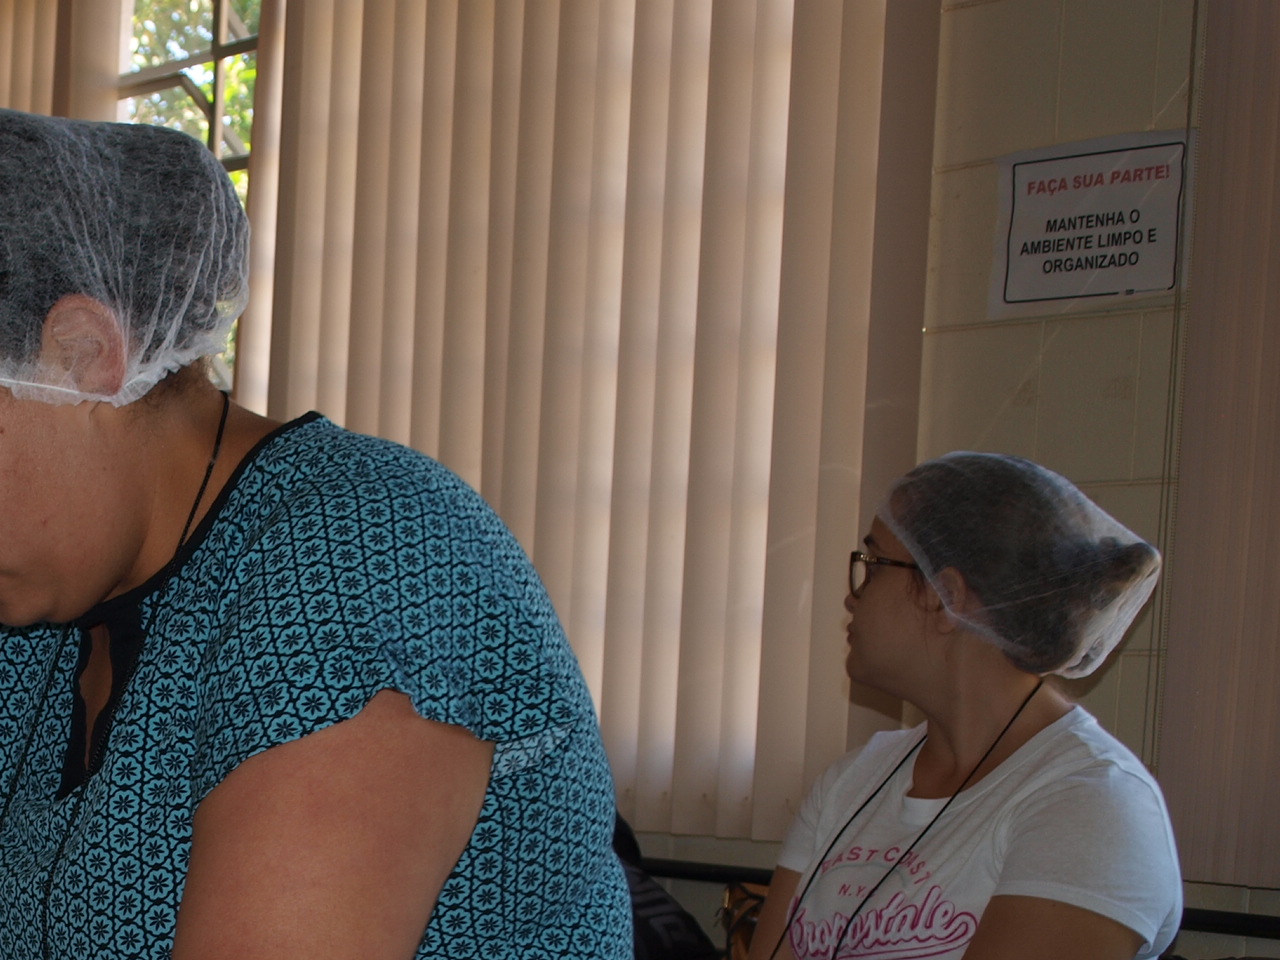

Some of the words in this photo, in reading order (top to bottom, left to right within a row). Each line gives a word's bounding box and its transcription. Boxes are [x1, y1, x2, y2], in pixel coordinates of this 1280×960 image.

[1027, 178, 1067, 195] FAÇA
[1073, 173, 1104, 189] SUA
[1110, 164, 1170, 184] PARTE!
[1045, 211, 1125, 233] MANTENHA
[1129, 209, 1140, 224] O
[1020, 235, 1093, 256] AMBIENTE
[1098, 230, 1143, 248] LIMPO
[1148, 228, 1157, 243] E
[1042, 251, 1139, 274] ORGANIZADO
